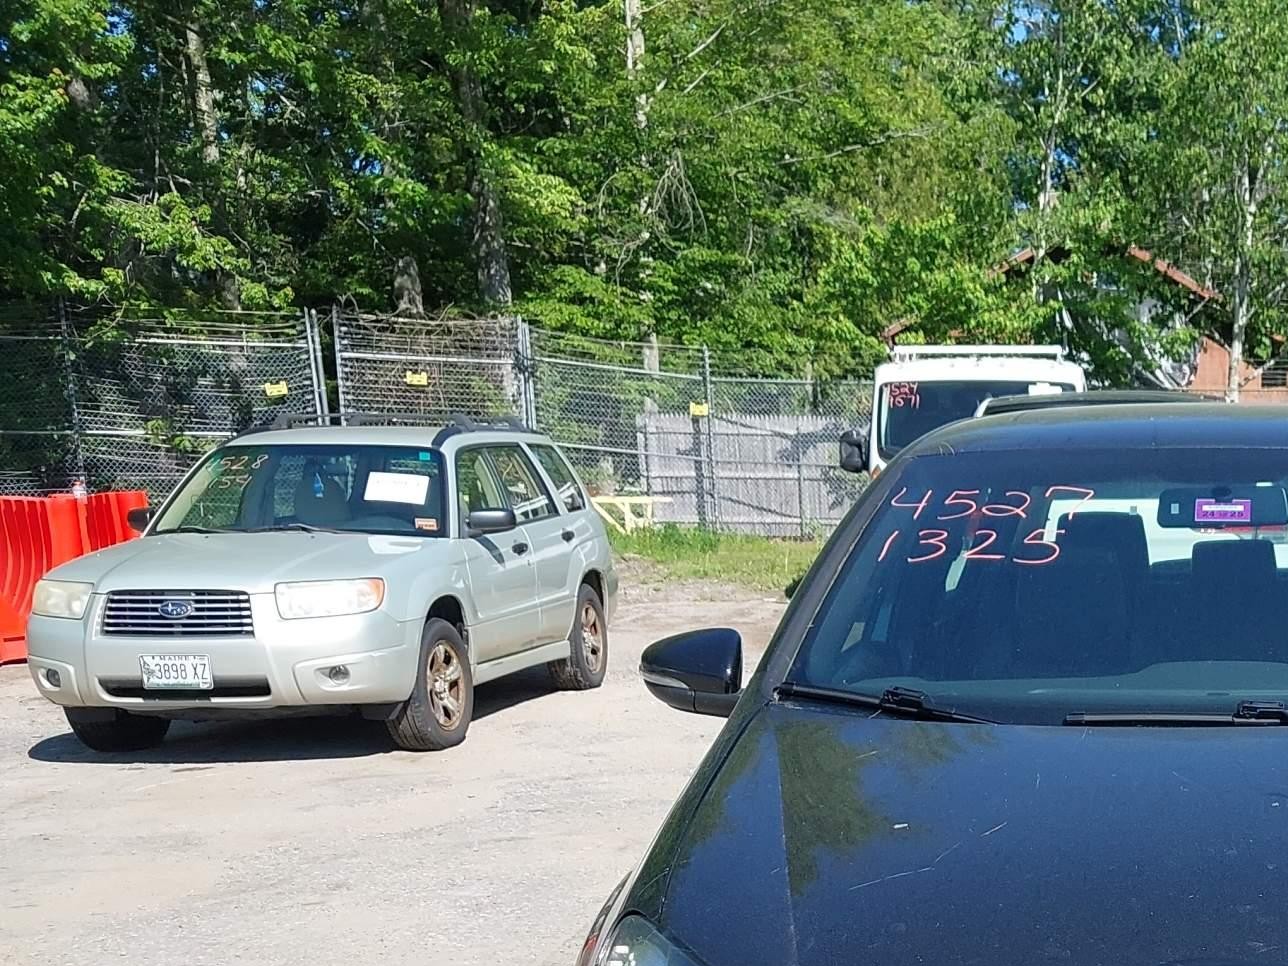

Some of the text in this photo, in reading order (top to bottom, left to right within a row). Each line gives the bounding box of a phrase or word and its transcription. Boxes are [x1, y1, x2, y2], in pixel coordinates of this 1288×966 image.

[891, 486, 1095, 521] 4527
[877, 528, 1066, 564] 1325
[155, 663, 209, 680] 3898 XZ
